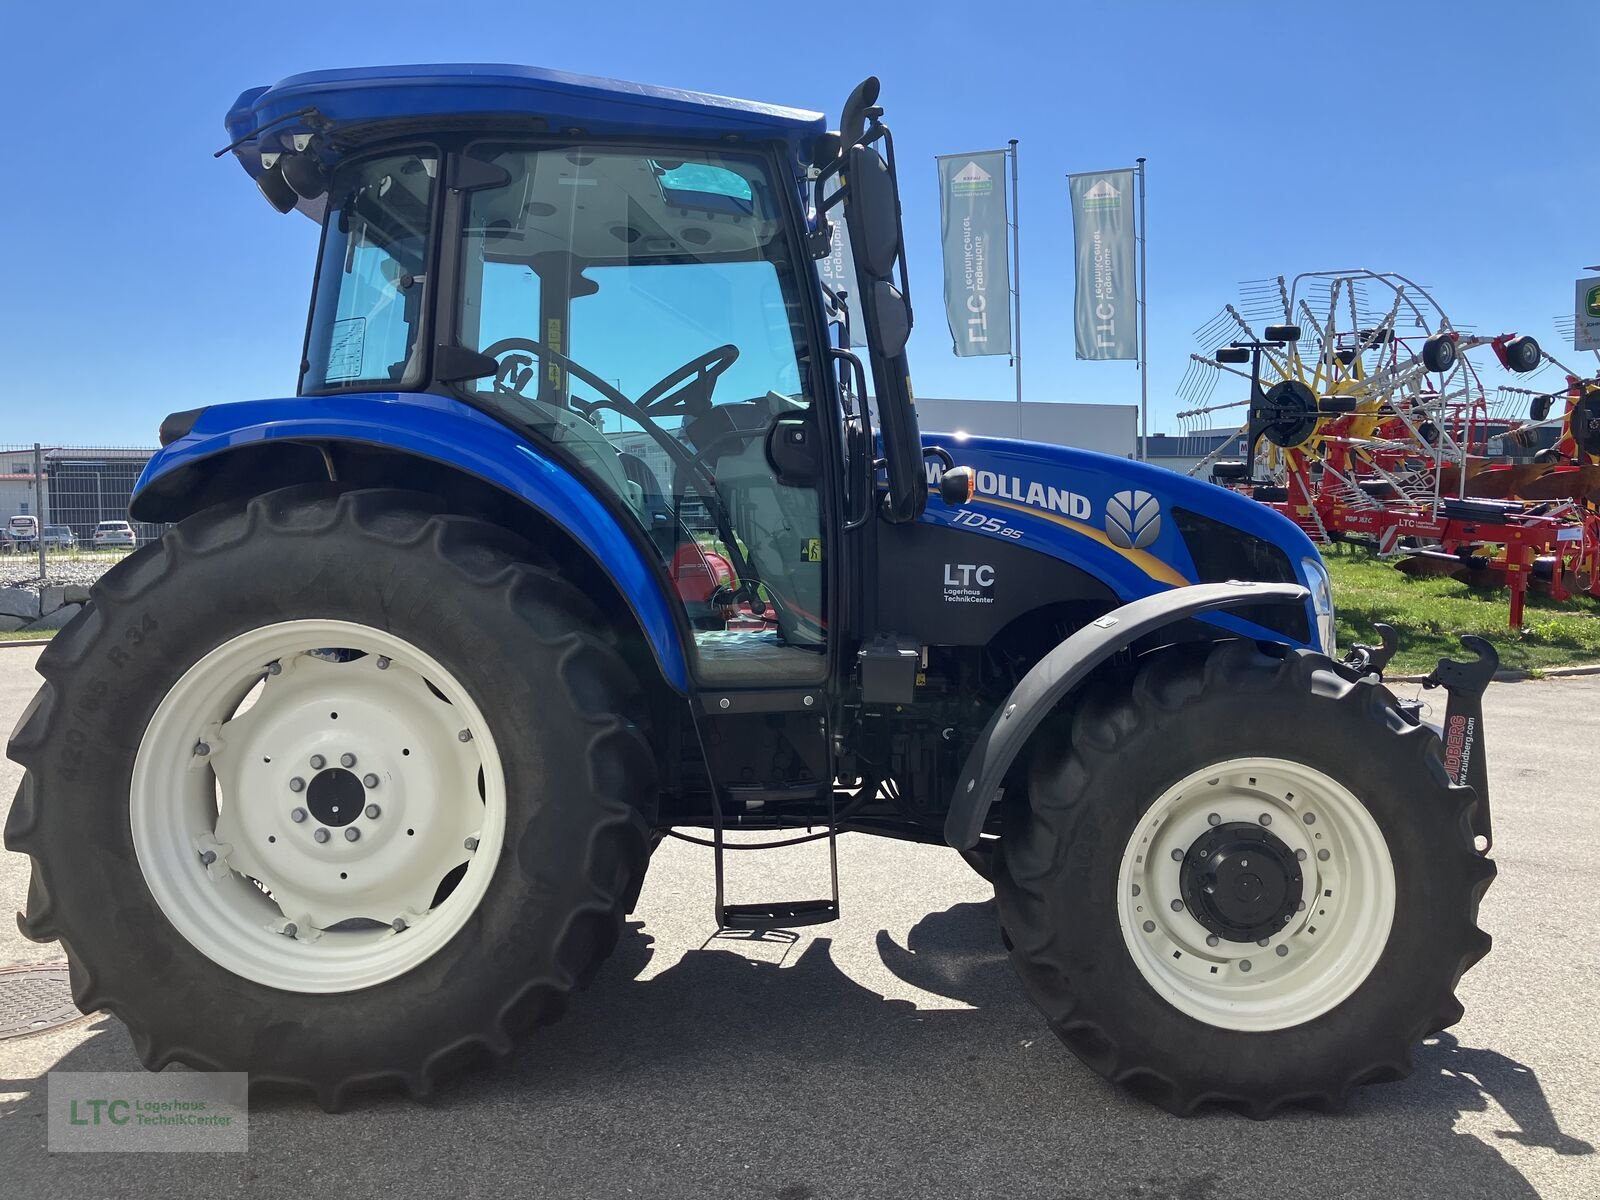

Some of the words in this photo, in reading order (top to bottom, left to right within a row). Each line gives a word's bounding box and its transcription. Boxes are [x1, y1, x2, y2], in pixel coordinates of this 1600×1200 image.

[971, 469, 1092, 520] OLLAND
[952, 508, 1024, 540] TD5.85
[1399, 518, 1415, 528] LTC
[944, 563, 995, 587] LTC
[944, 587, 980, 596] Lagerhaus
[944, 596, 994, 604] TechnikCenter
[1444, 715, 1467, 782] UIDBERG
[1460, 717, 1475, 786] ww.zuidberg.com
